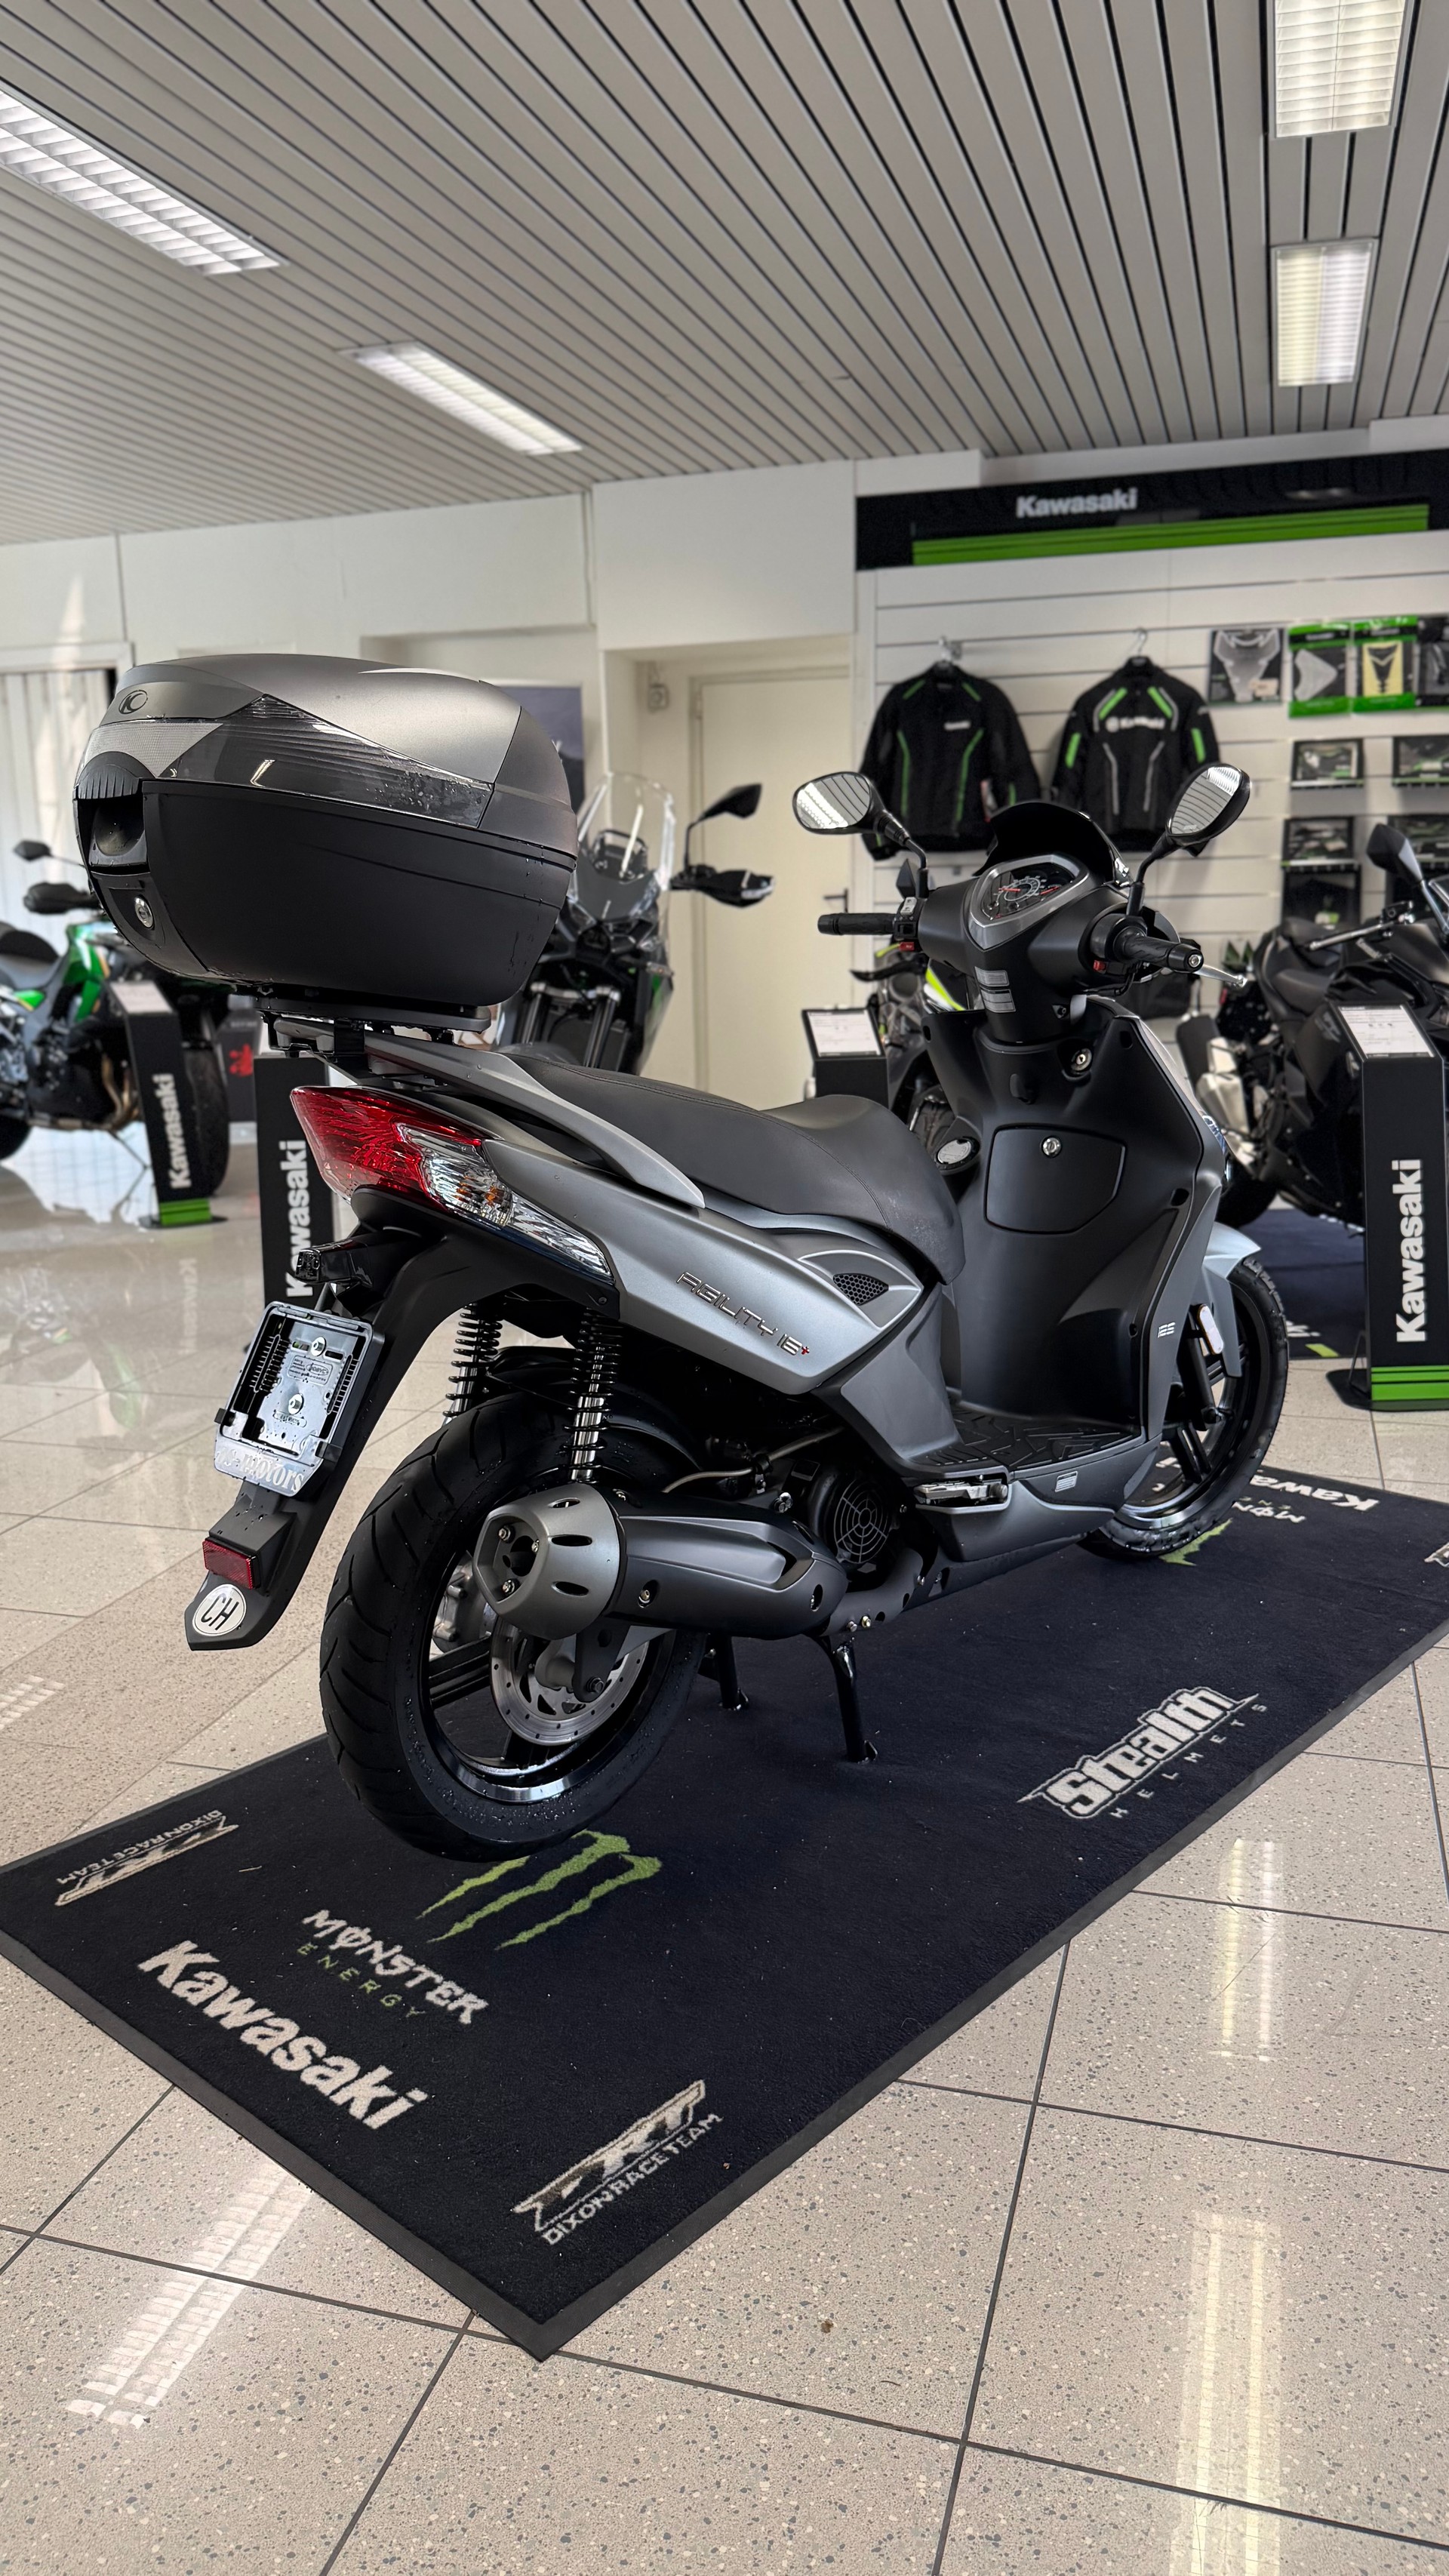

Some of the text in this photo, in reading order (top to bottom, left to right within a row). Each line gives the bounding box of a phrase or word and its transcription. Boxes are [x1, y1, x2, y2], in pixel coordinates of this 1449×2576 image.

[1017, 488, 1137, 519] Kawasaki
[152, 1073, 192, 1189] Kawasaki
[676, 1272, 778, 1336] AGILITY
[1392, 1159, 1426, 1342] Kawasaki
[201, 1593, 239, 1630] CH
[1042, 1687, 1238, 1818] Stealth
[1110, 1703, 1267, 1818] HELMETS
[137, 1940, 429, 2130] Kawasaki
[297, 1942, 426, 2018] ENERGY
